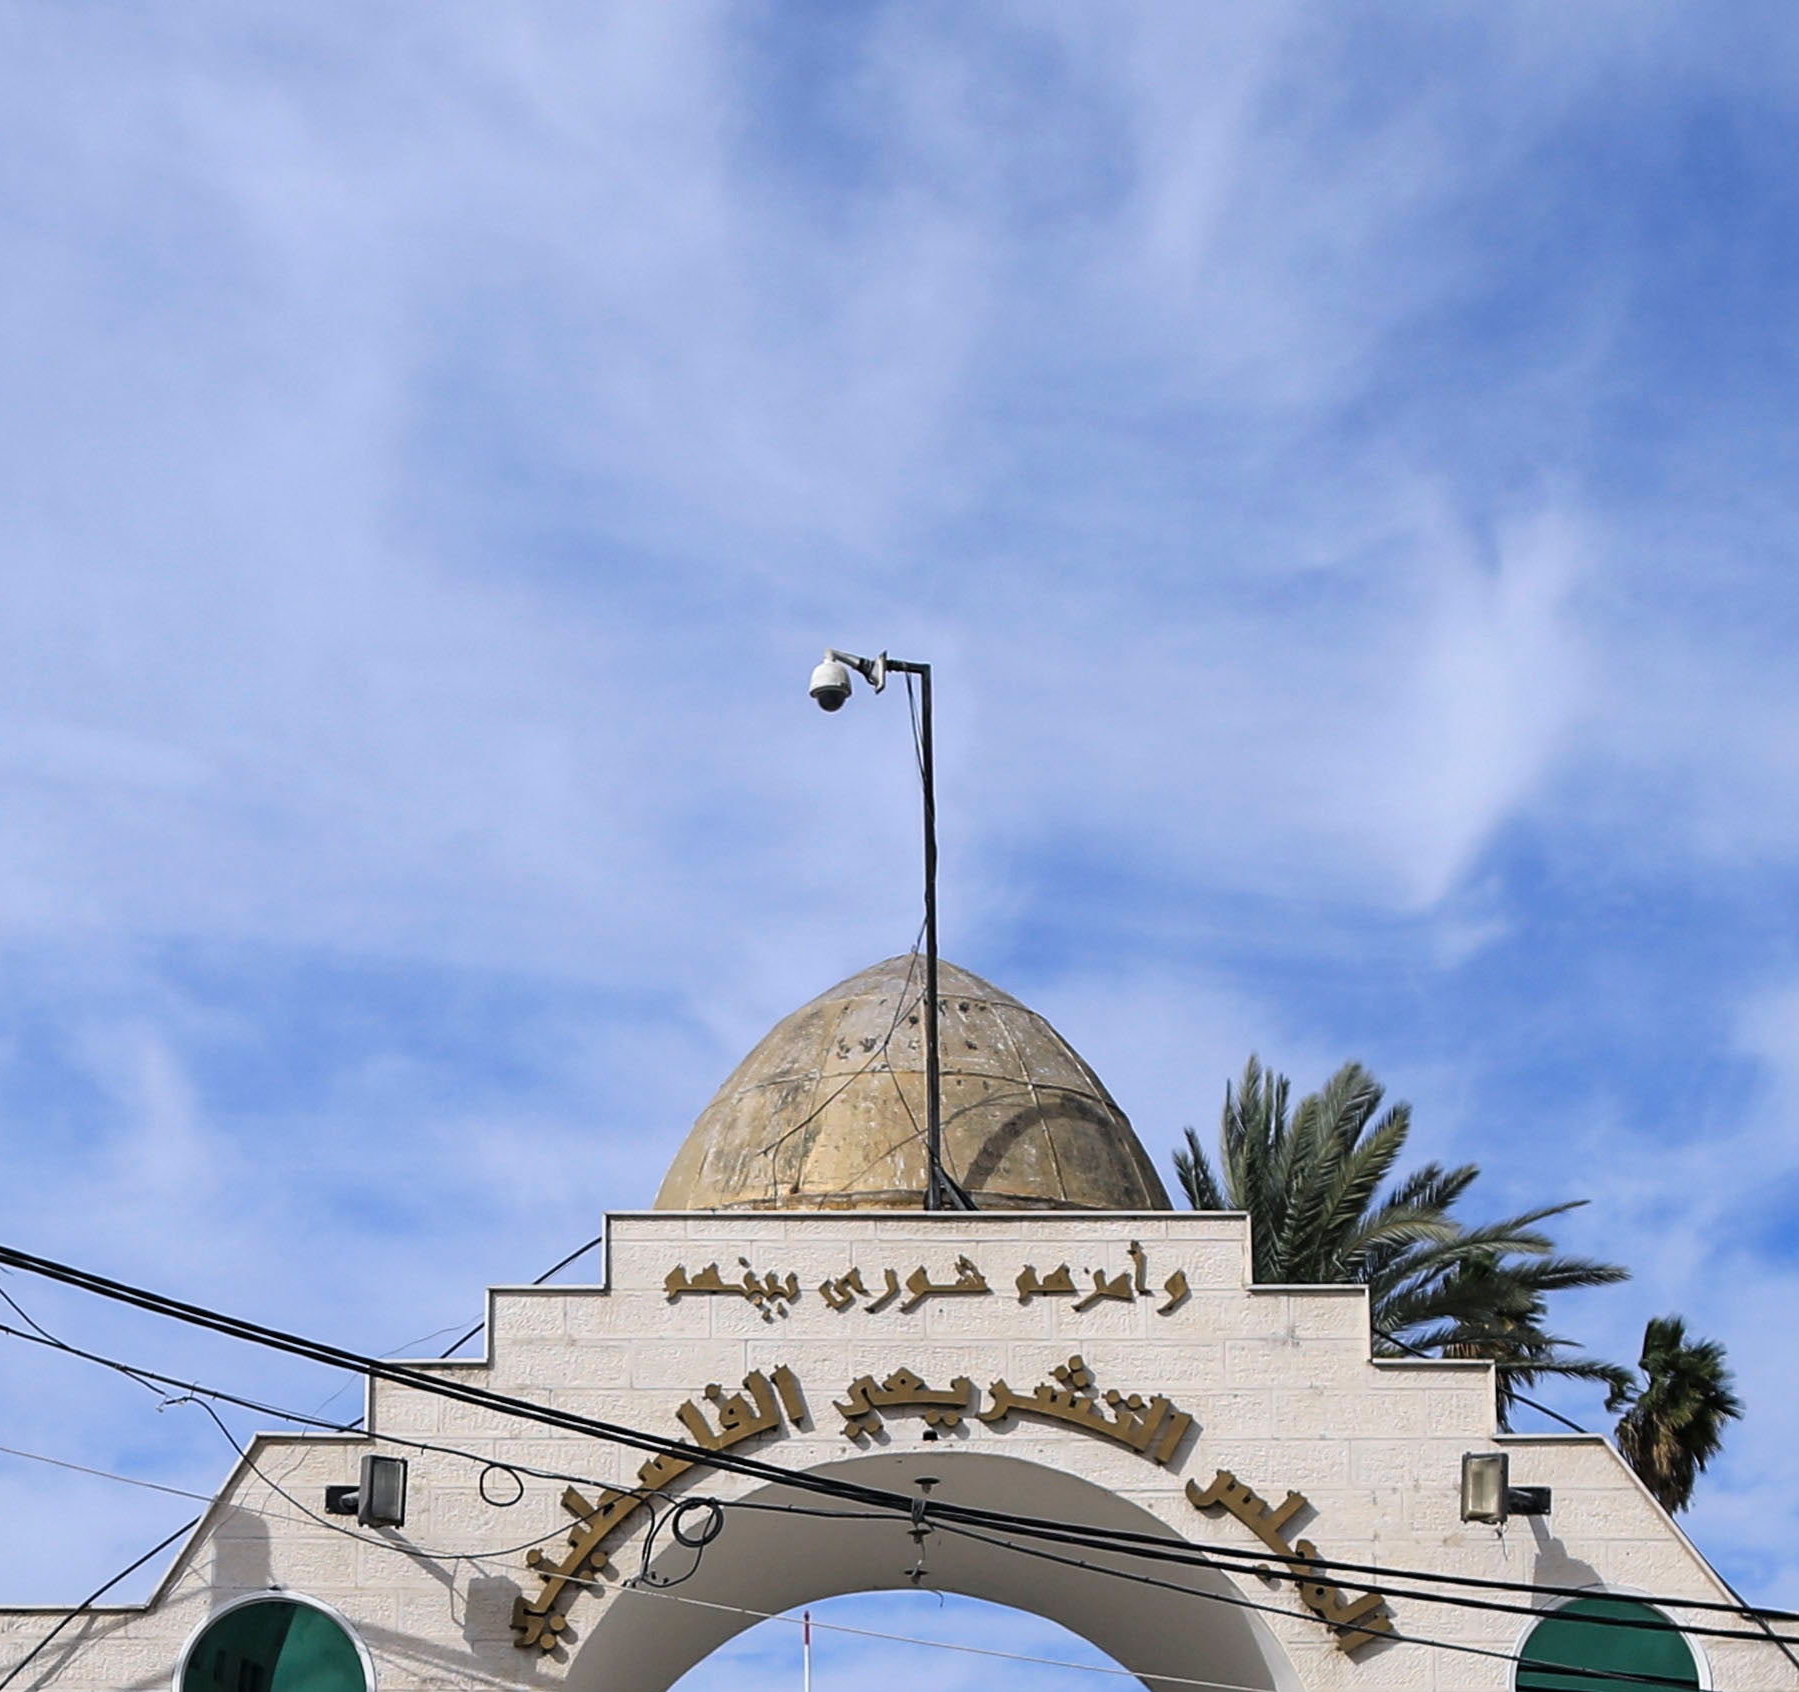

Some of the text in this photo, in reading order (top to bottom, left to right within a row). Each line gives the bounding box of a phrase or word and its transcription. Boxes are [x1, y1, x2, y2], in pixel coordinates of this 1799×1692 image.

[664, 1256, 800, 1322] بينهم
[817, 1254, 994, 1314] شورى
[509, 1354, 1394, 1652] المجلس التشريعي الفلسطيني
